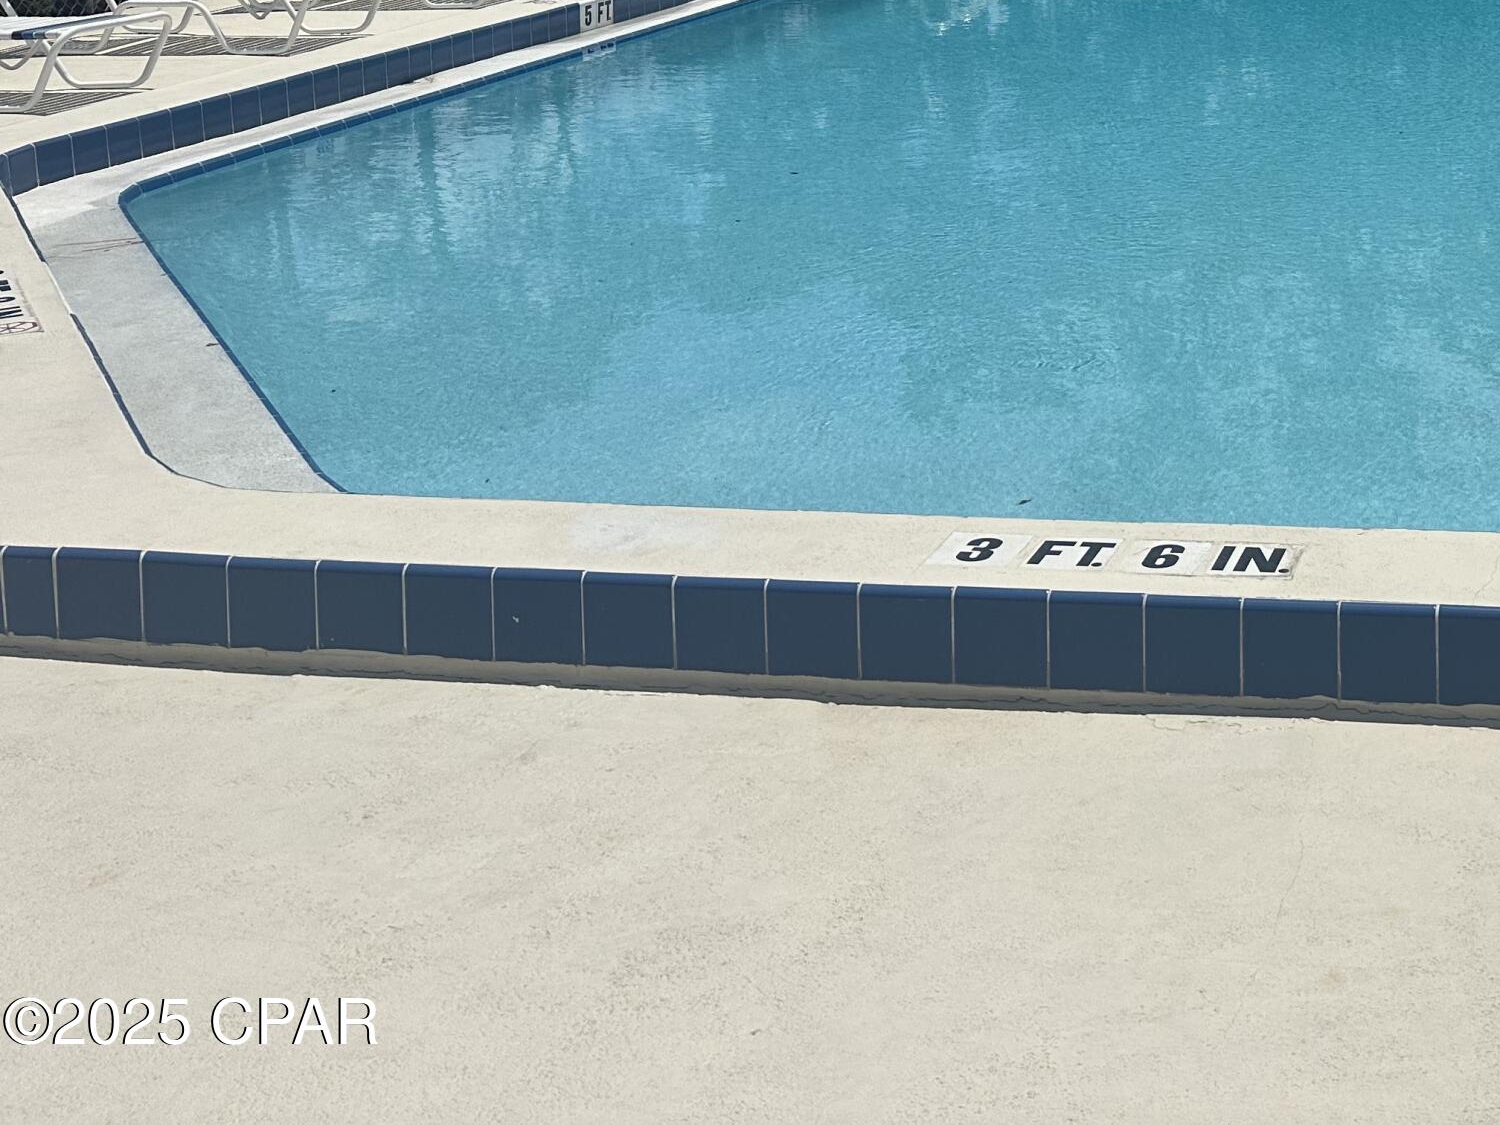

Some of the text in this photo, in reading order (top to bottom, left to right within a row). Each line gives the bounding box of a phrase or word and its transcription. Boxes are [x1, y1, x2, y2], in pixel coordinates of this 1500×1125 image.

[584, 4, 592, 26] 5
[955, 537, 1290, 573] 3 FT. 6 IN.
